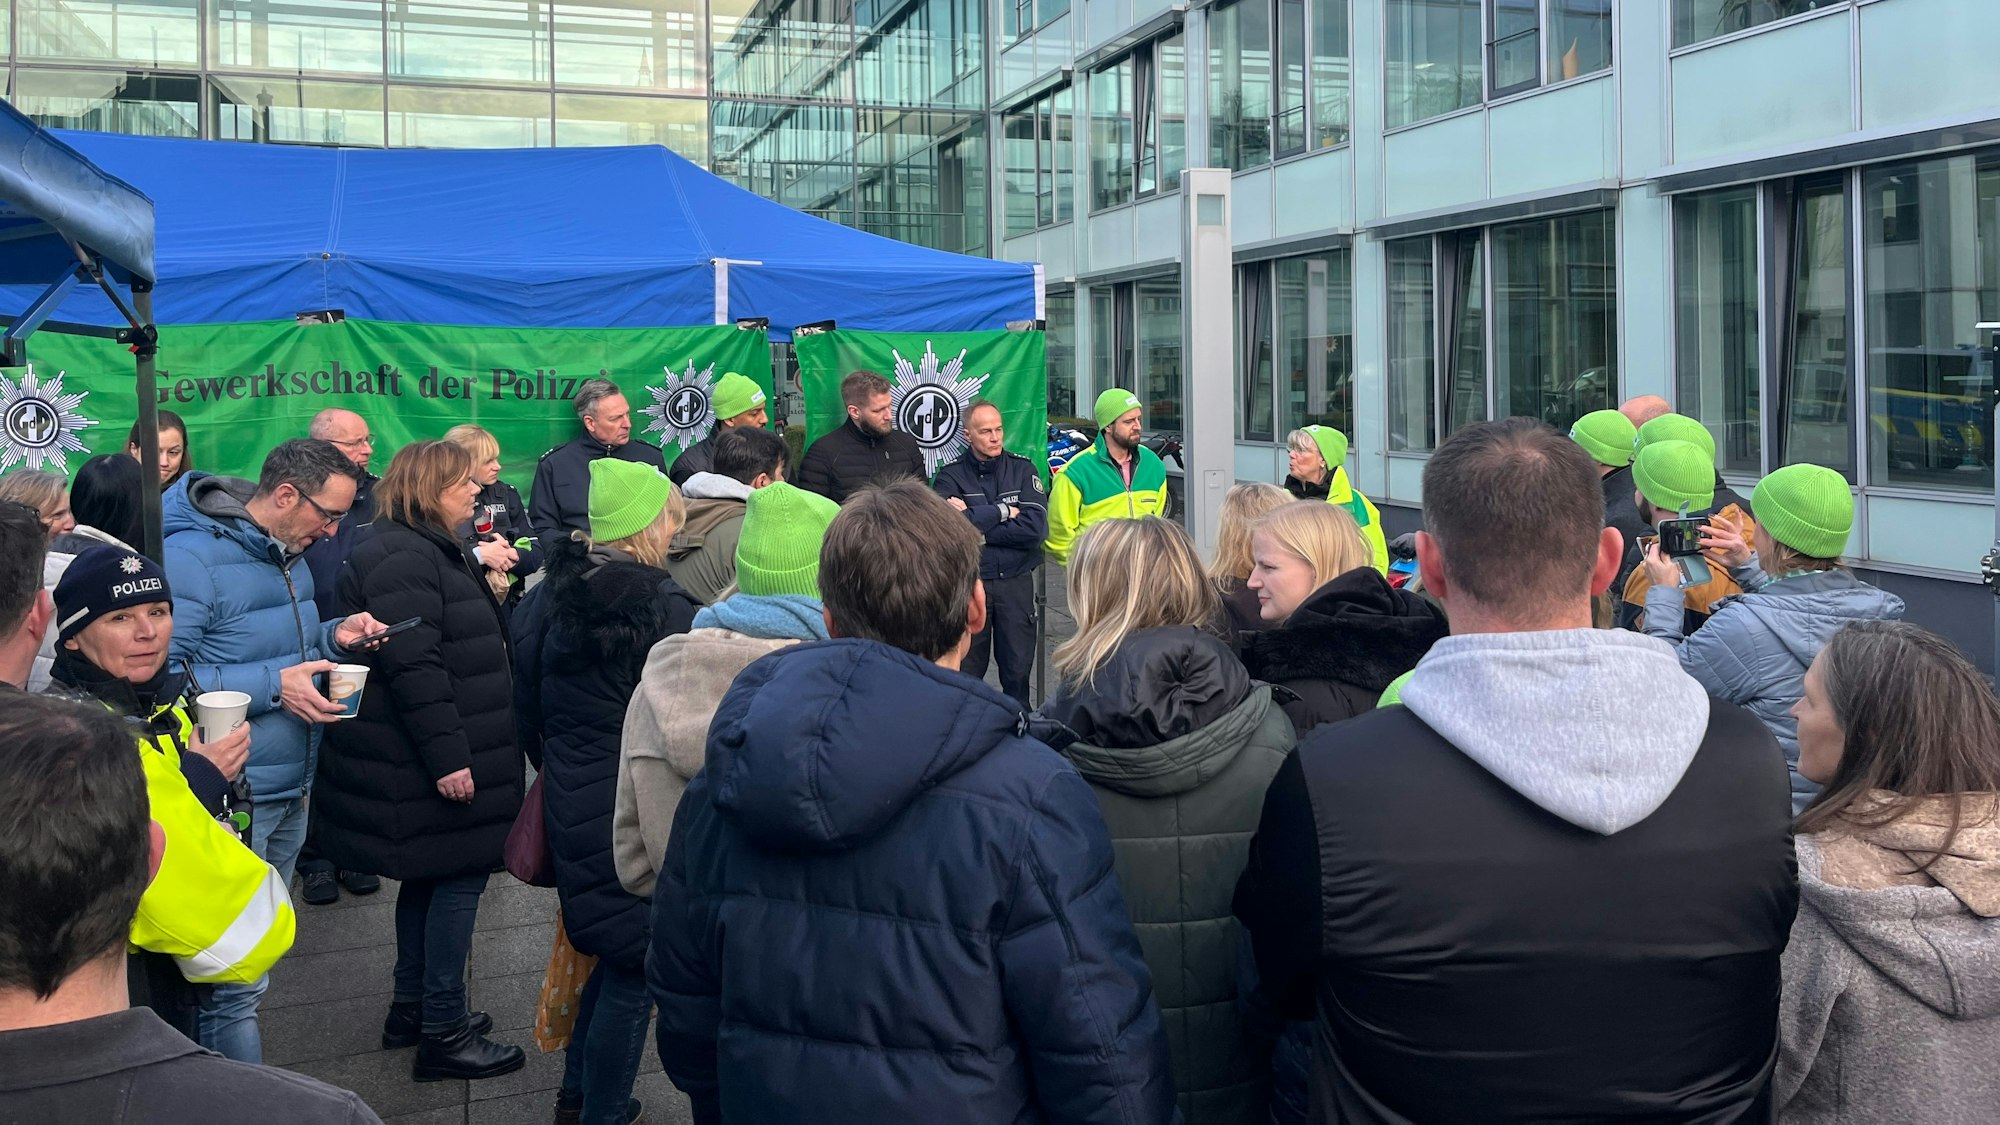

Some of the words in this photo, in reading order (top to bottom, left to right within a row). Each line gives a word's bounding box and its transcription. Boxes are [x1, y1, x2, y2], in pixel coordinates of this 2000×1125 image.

[418, 366, 478, 399] der
[488, 368, 608, 400] Poliz
[112, 577, 163, 598] POLIZEI
